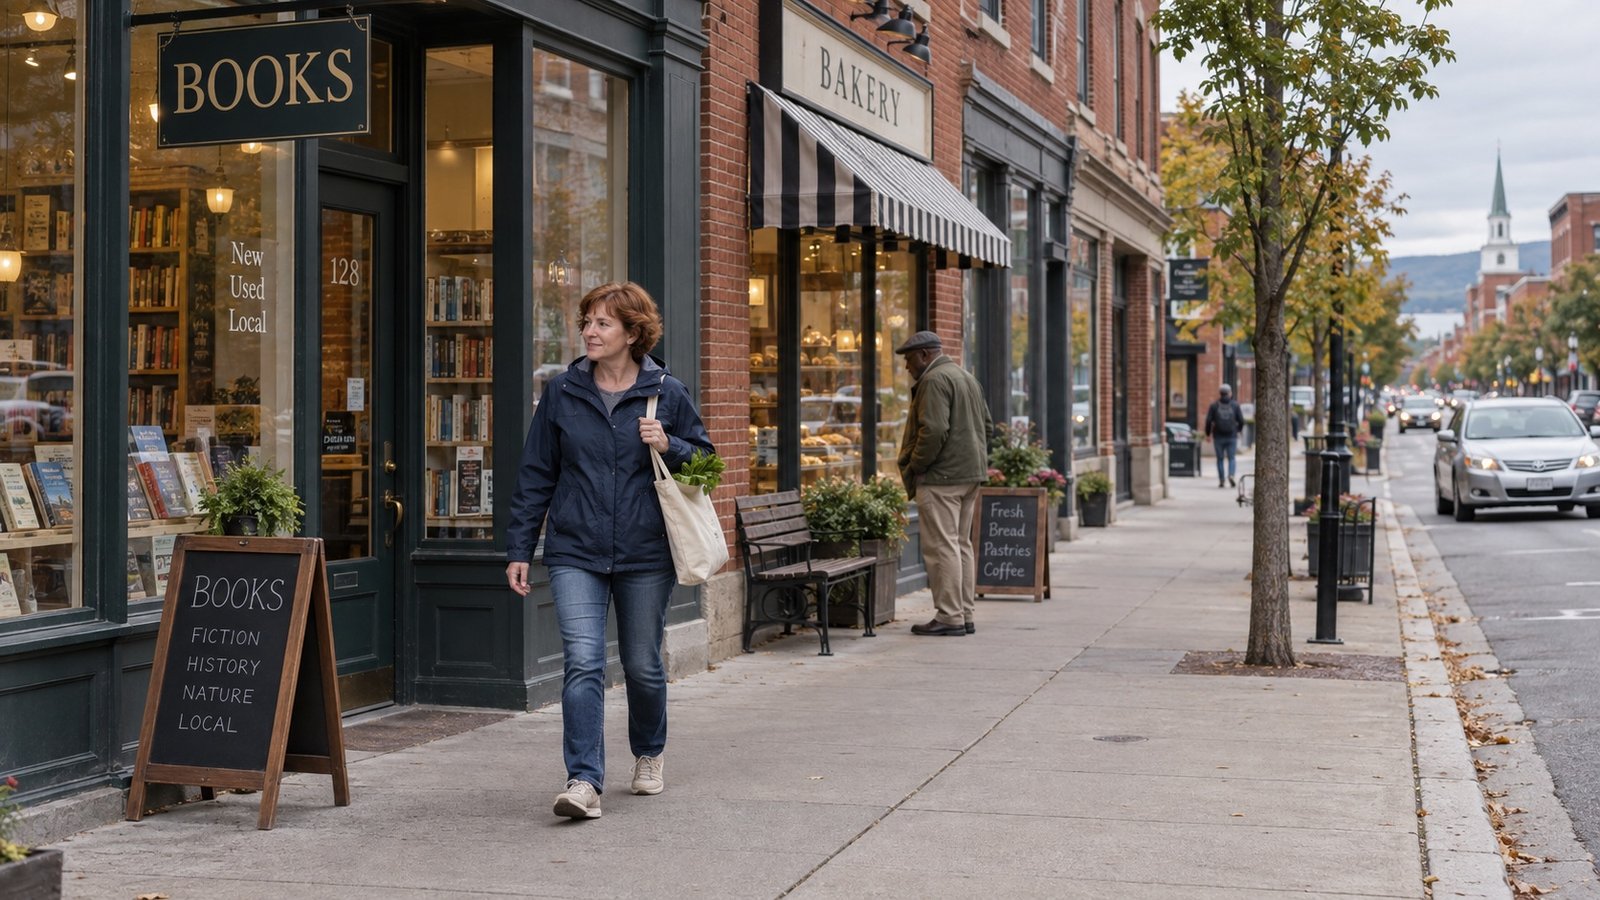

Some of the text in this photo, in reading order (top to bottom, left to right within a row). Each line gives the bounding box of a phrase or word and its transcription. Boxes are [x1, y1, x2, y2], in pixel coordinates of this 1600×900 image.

[173, 48, 353, 114] BOOKS
[820, 46, 901, 127] BAKERY
[231, 241, 264, 266] New
[330, 257, 360, 286] 128
[230, 275, 265, 300] Used
[229, 308, 267, 333] Local
[991, 502, 1024, 518] Fresh
[989, 522, 1025, 538] Bread
[984, 542, 1031, 557] Pastries
[984, 561, 1025, 579] Coffee
[191, 575, 285, 611] BOOKS
[191, 627, 260, 646] FICTION
[186, 656, 260, 676] HISTORY
[182, 685, 254, 704] NATURE
[178, 713, 238, 733] LOCAL
